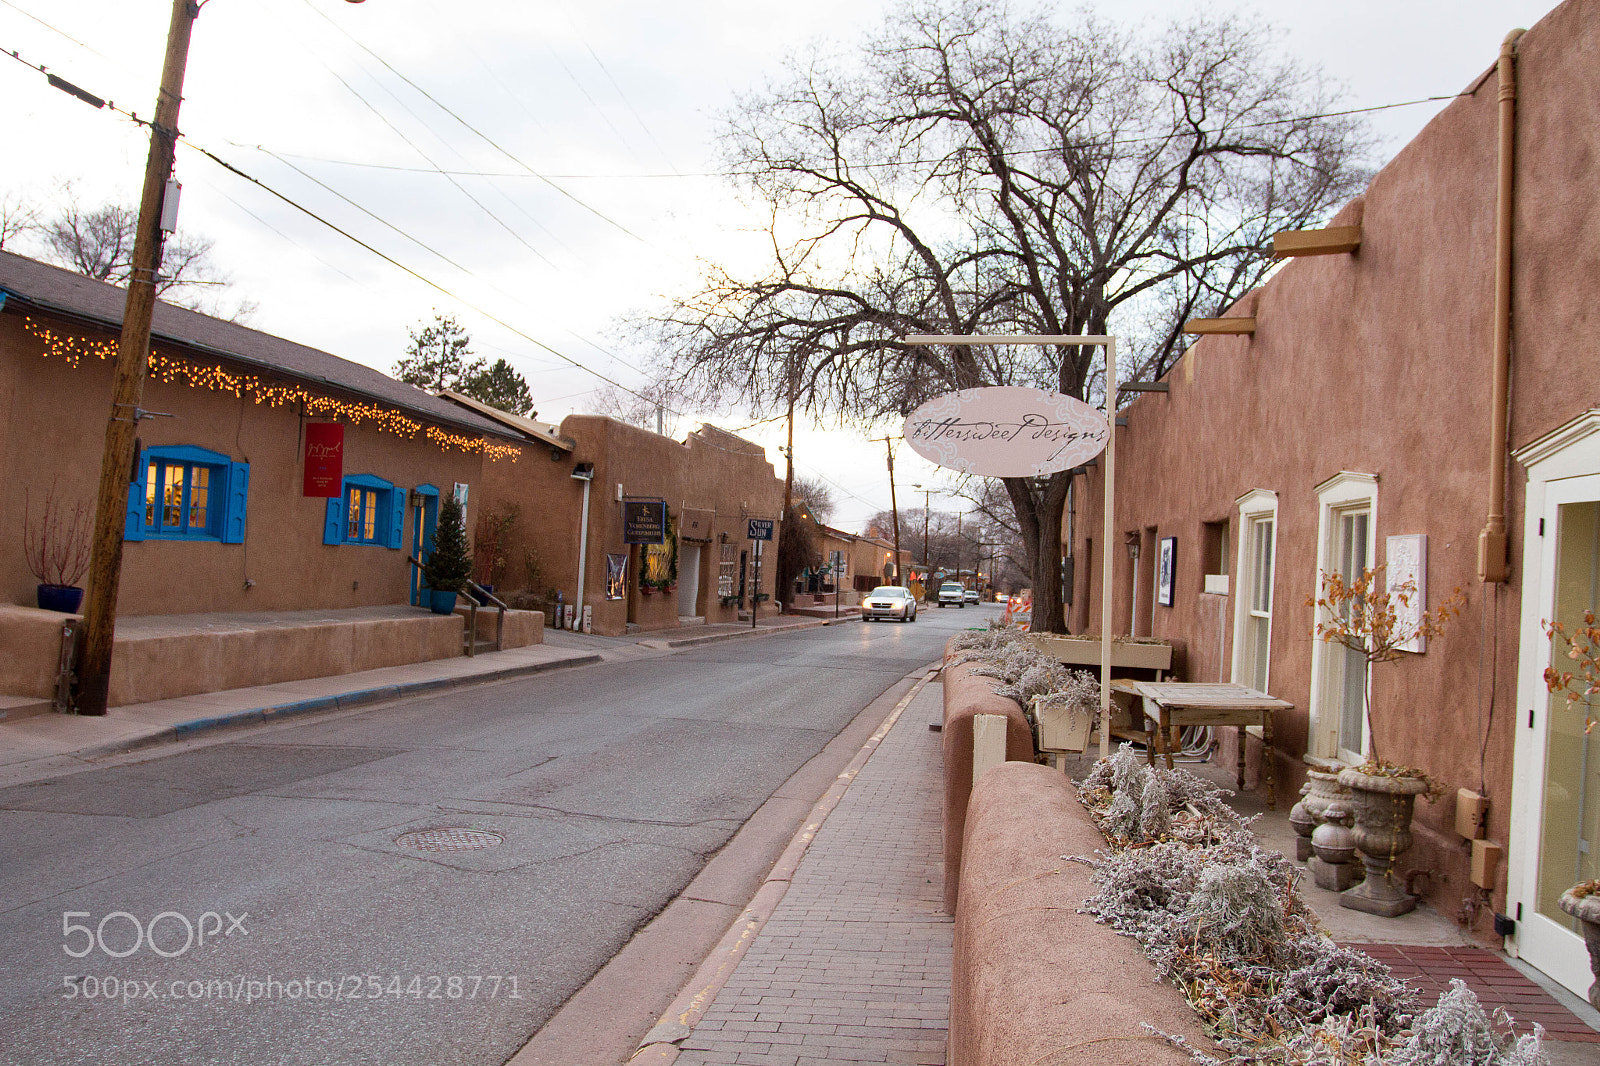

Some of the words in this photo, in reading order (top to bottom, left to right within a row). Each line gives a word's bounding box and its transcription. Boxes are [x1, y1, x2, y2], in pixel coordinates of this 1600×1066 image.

[912, 418, 1034, 442] bittersweet
[1023, 414, 1105, 462] designs
[750, 520, 772, 534] SILVER
